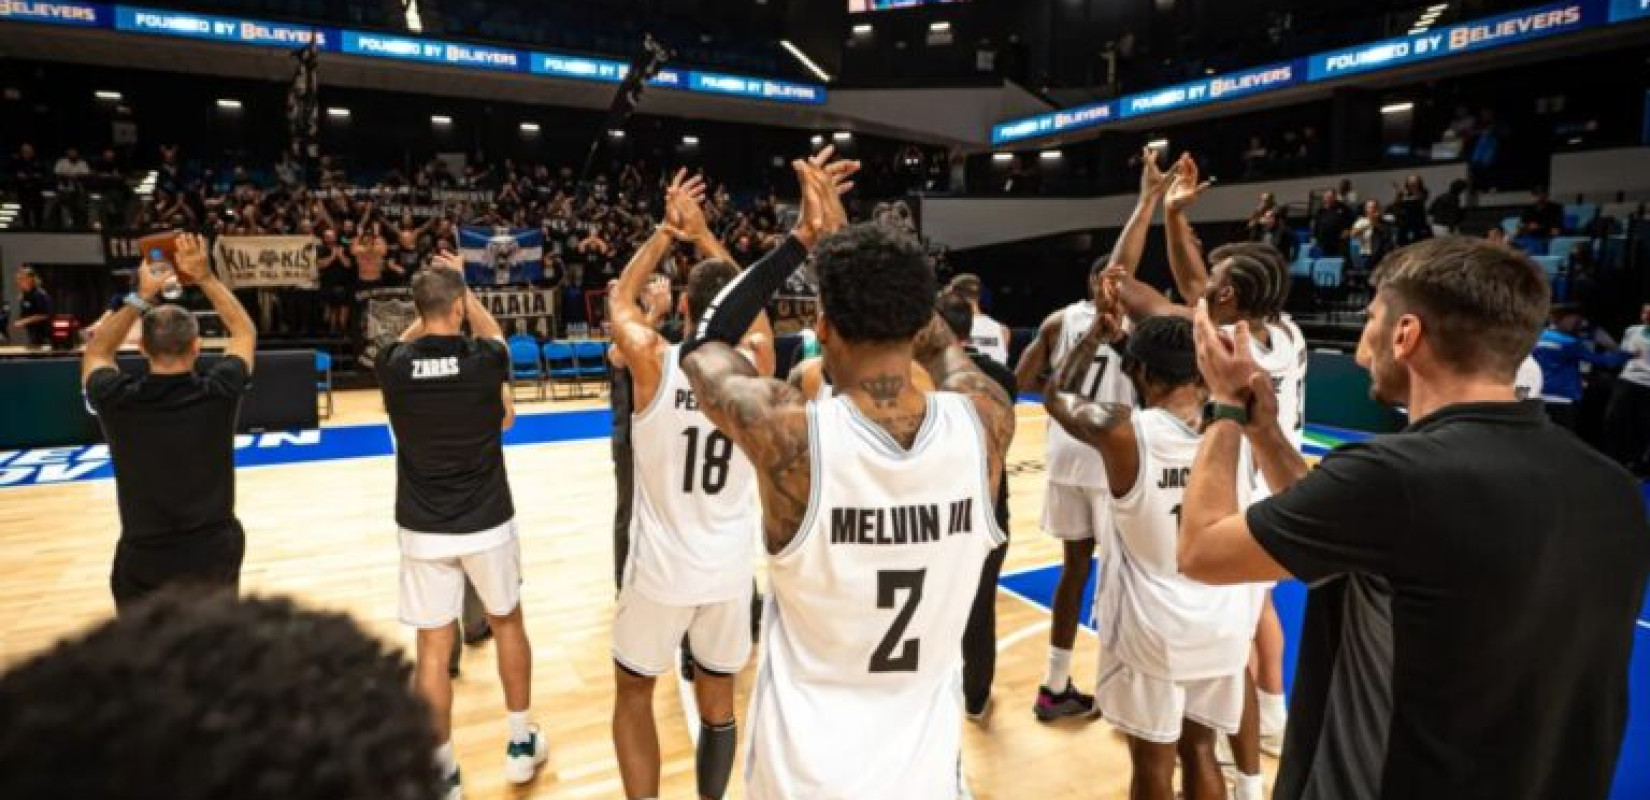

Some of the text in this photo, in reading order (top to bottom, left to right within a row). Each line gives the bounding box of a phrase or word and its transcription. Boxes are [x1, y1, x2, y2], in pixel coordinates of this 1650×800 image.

[214, 21, 236, 35] BY
[1414, 34, 1441, 53] BY
[1449, 6, 1581, 48] BELIEVERS
[674, 388, 699, 411] PE
[681, 425, 734, 495] 18
[831, 497, 973, 544] MELVIN III
[868, 565, 927, 673] 2
